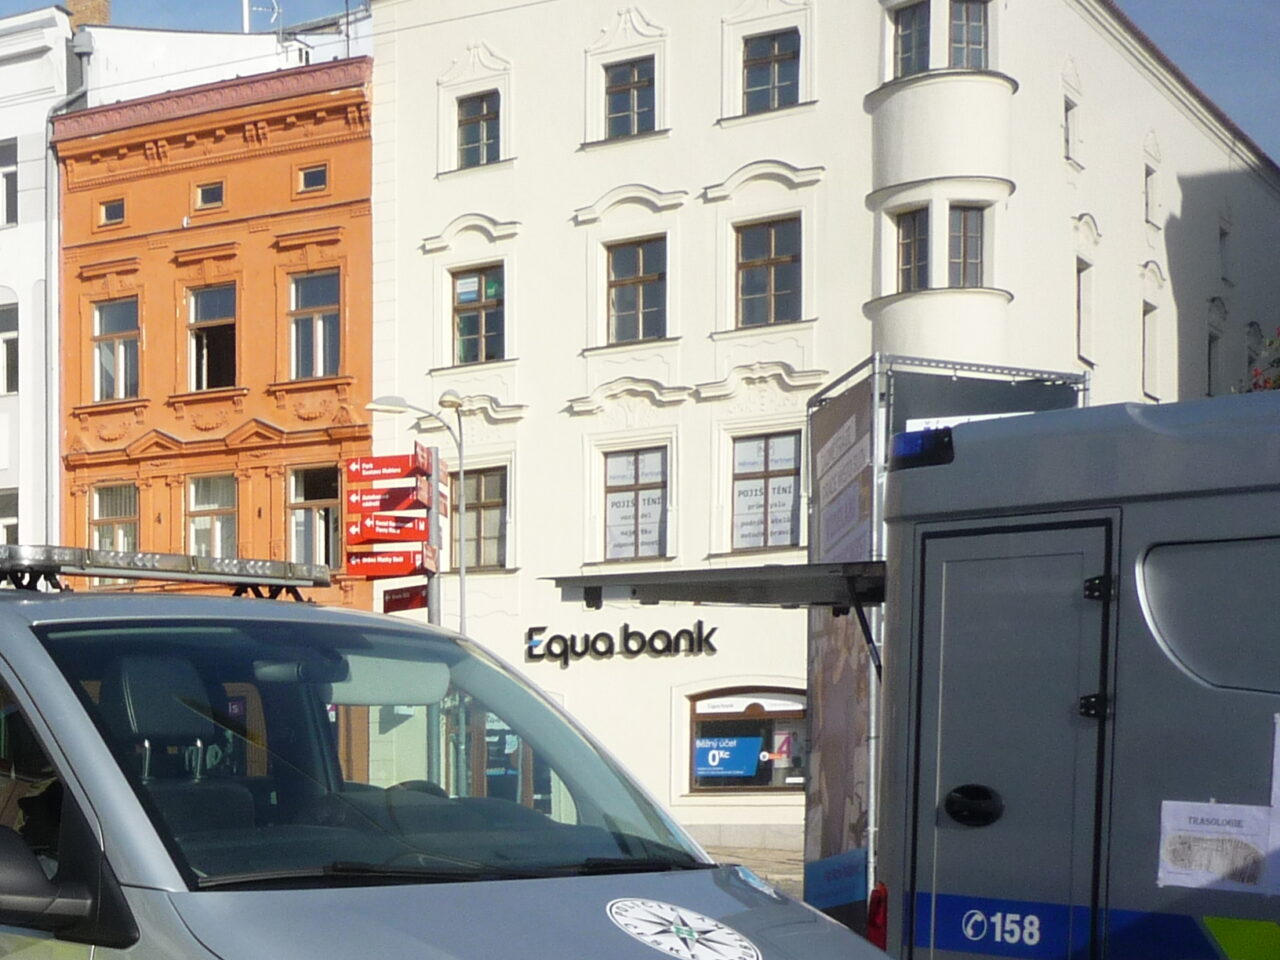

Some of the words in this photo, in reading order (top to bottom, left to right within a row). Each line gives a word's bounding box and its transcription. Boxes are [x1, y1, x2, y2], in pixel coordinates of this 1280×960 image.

[528, 626, 615, 666] Equa
[623, 619, 718, 656] bank
[990, 912, 1040, 946] 158
